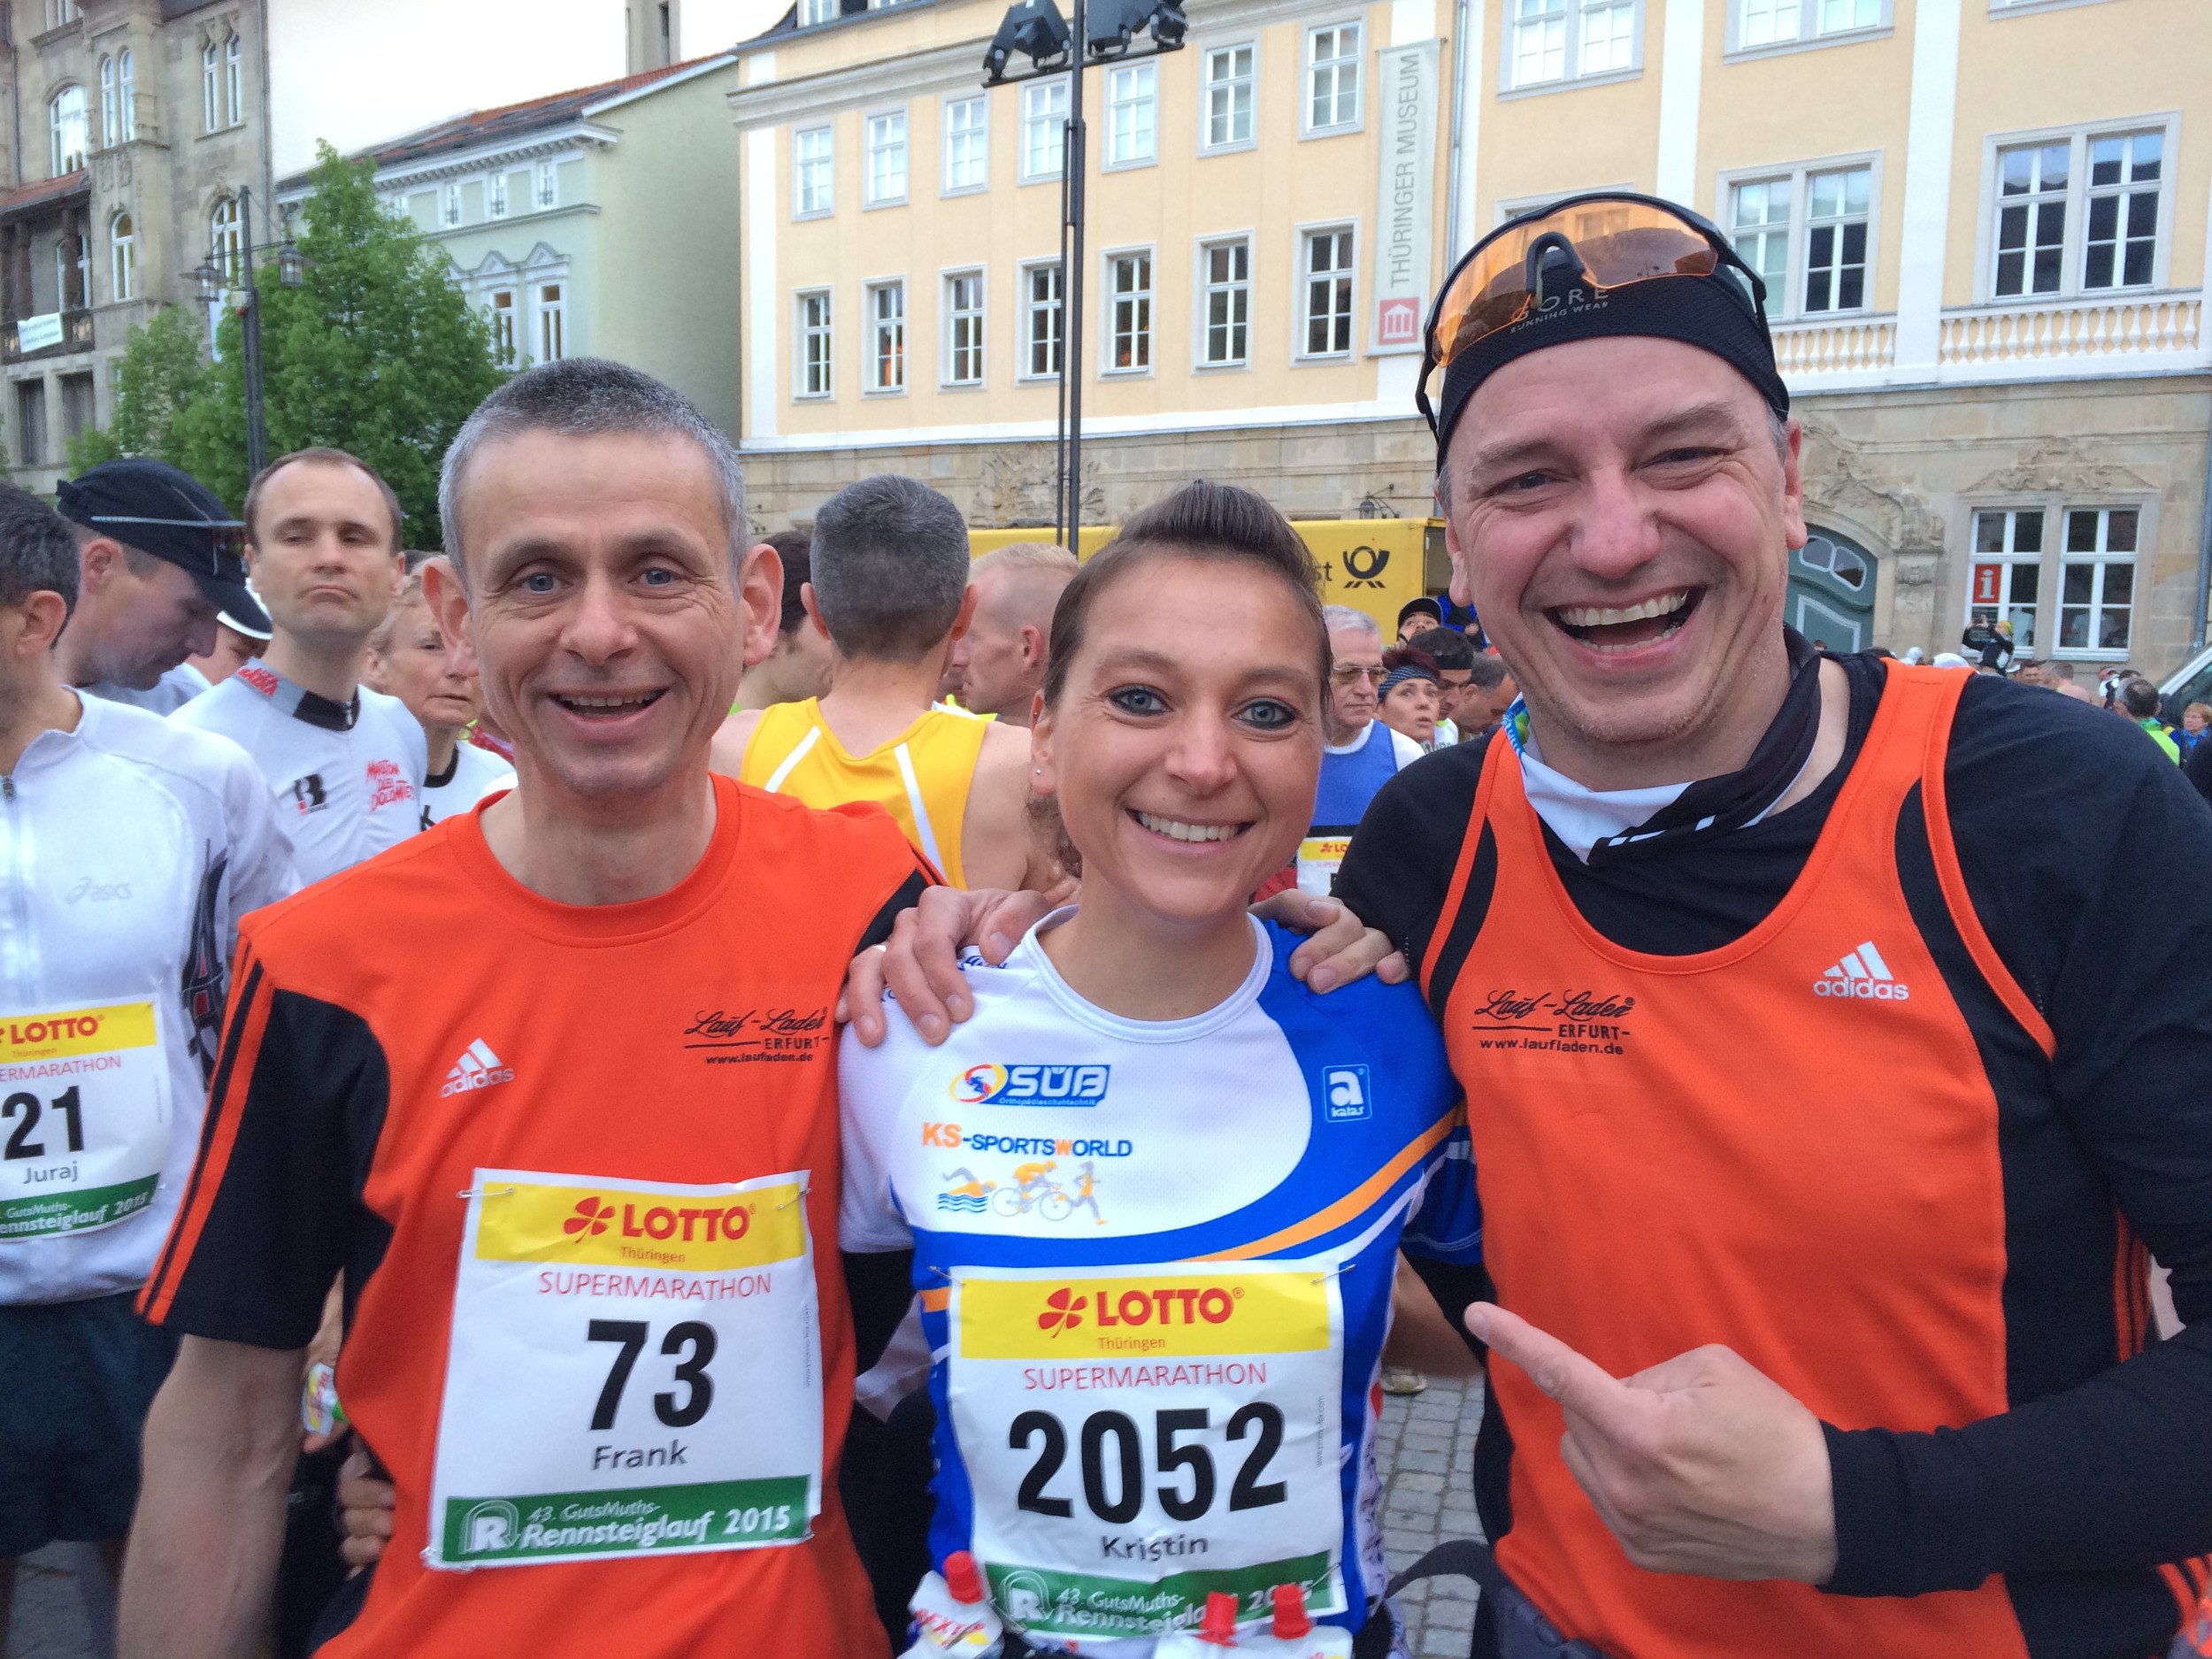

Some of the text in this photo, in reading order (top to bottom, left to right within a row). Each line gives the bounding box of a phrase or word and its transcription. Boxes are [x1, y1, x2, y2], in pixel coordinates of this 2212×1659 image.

[1388, 53, 1419, 288] THÜRINGER MUSEUM
[1572, 301, 1609, 313] WEAR
[1813, 975, 1909, 1002] adidas
[11, 1016, 98, 1045] LOTTO
[1479, 1037, 1624, 1055] www.laufladen.de
[440, 1065, 515, 1099] adidas
[1, 1086, 85, 1161] 21
[922, 1122, 1133, 1157] KS-SPORTSWORLD
[23, 1161, 79, 1185] Juraj
[622, 1203, 749, 1241] LOTTO
[621, 1246, 685, 1263] Thüringen
[539, 1271, 771, 1301] SUPERMARATHON
[1096, 1288, 1233, 1326] LOTTO
[1098, 1334, 1165, 1352] Thüringen
[588, 1318, 719, 1431] 73
[1024, 1362, 1266, 1390] SUPERMARATHON
[593, 1440, 688, 1471] Frank
[1009, 1401, 1289, 1525] 2052
[518, 1504, 792, 1550] Rennsteiglauf 2015
[1102, 1533, 1210, 1563] Kristin
